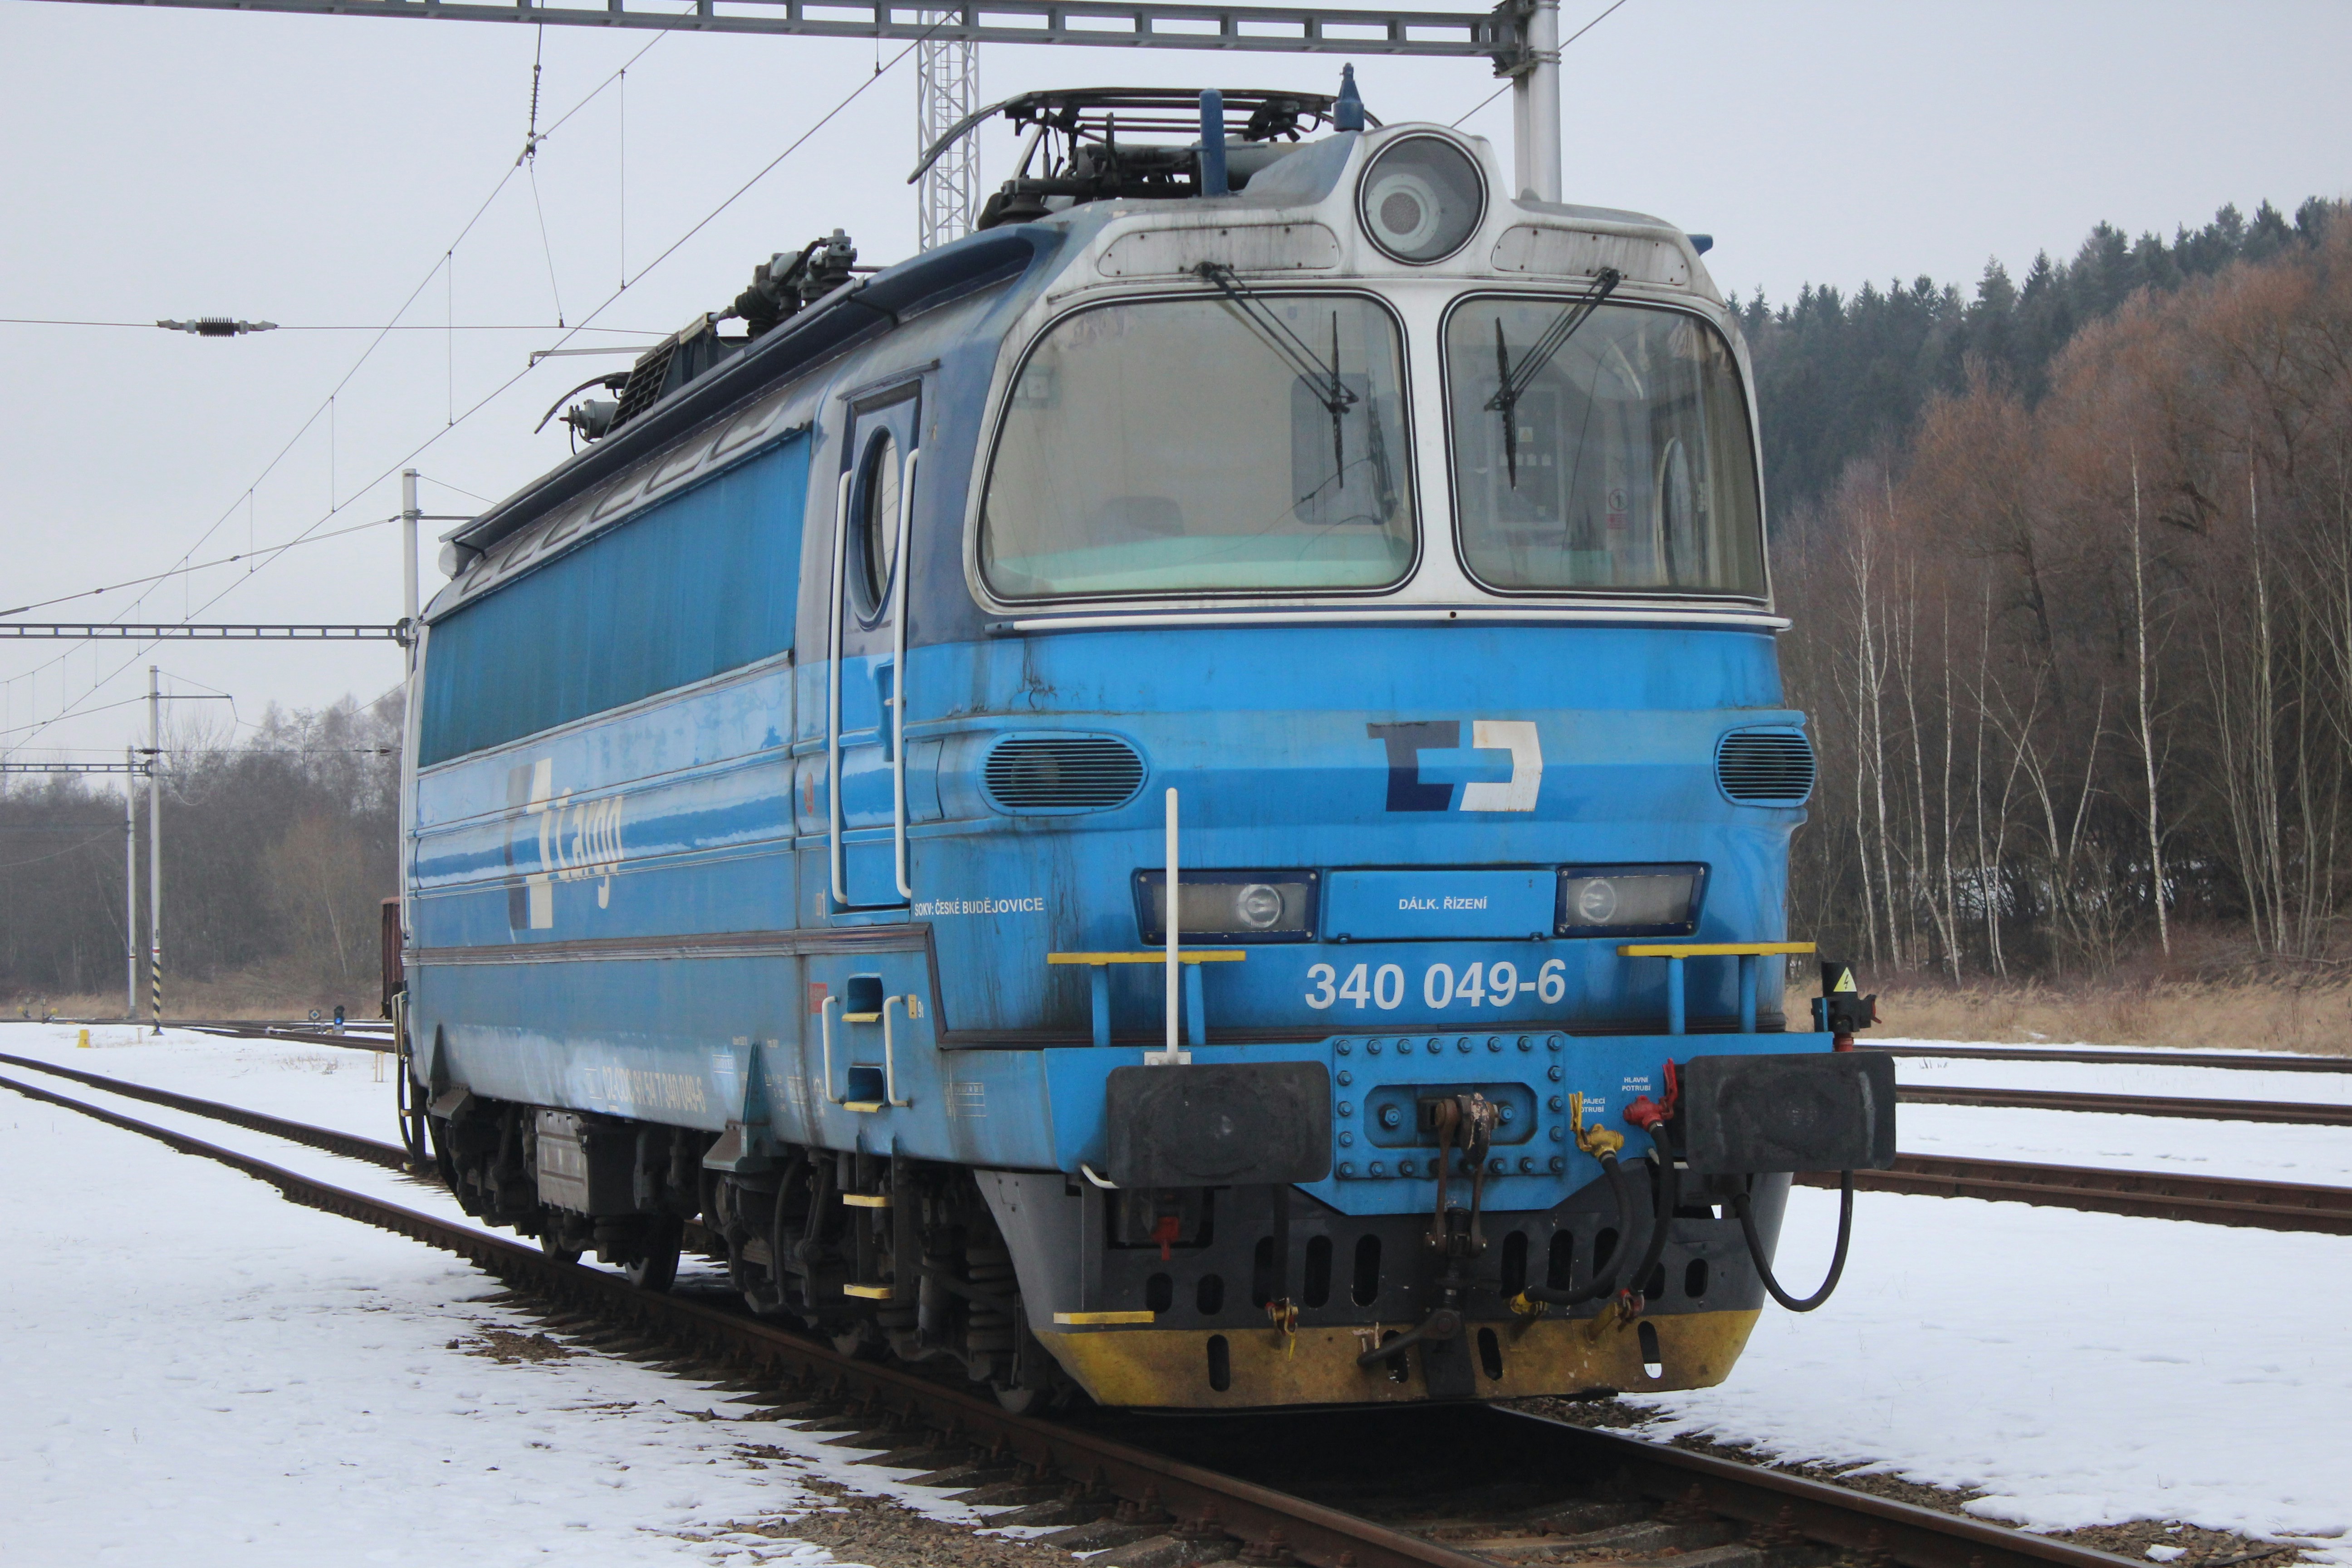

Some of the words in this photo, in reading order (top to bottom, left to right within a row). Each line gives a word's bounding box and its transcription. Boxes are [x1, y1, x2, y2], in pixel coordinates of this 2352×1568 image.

[914, 902, 934, 917] SOKV:
[935, 897, 960, 915] ČESKÉ
[962, 897, 1044, 914] BUDĚJOVICE
[1399, 896, 1439, 910] DÁLK.
[1443, 896, 1487, 910] ŘÍZENÍ
[1305, 963, 1405, 1010] 340
[1424, 959, 1566, 1009] 049-6
